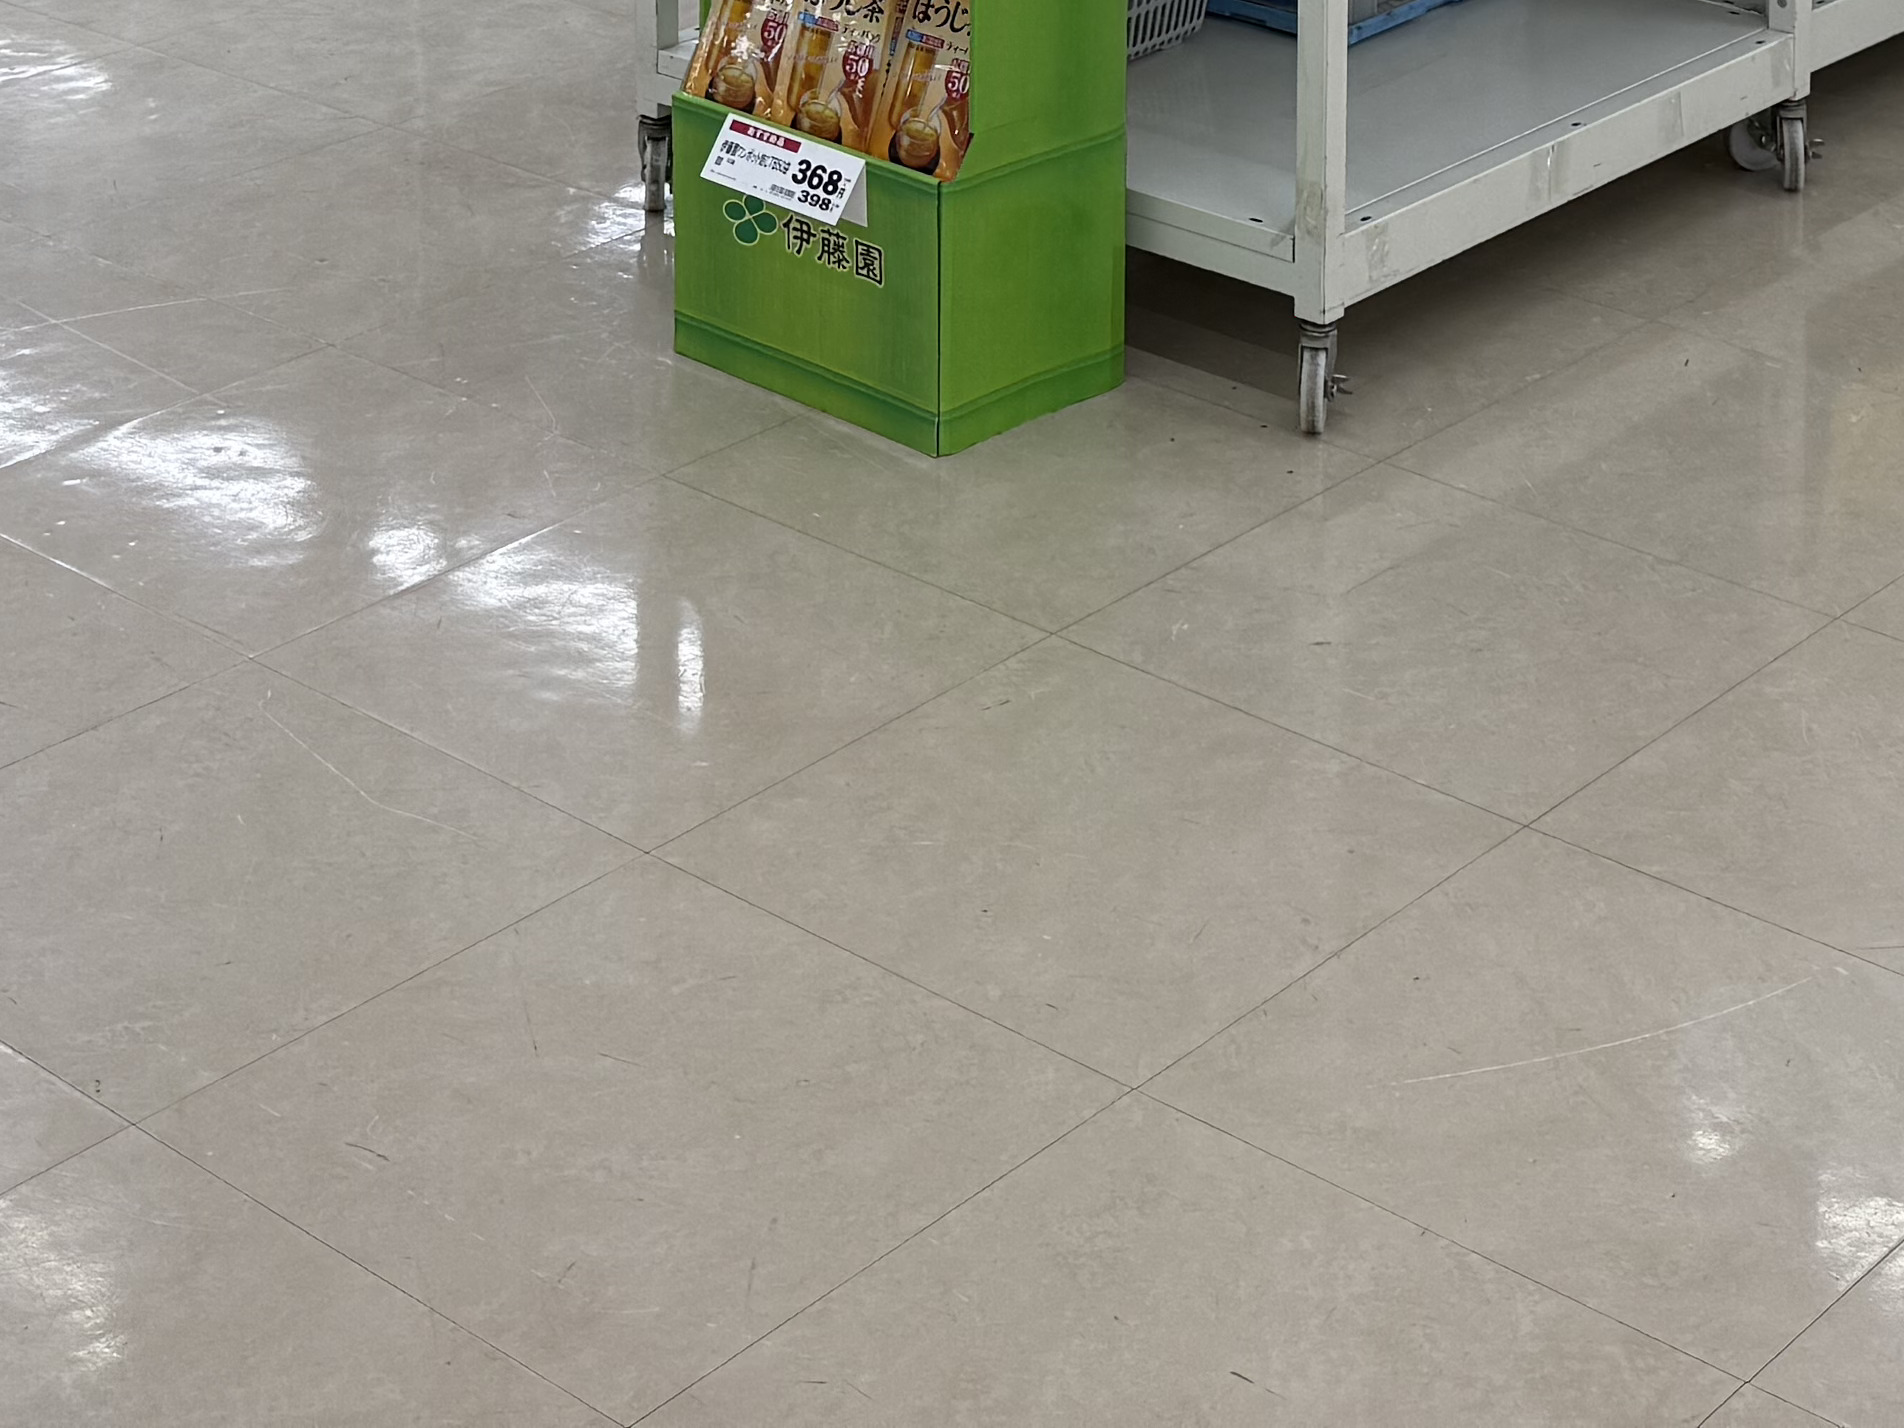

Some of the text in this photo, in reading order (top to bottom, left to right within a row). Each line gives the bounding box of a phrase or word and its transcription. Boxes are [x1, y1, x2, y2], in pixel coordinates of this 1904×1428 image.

[792, 159, 843, 196] 368
[797, 190, 831, 211] 398
[782, 213, 884, 286] 伊藤園
